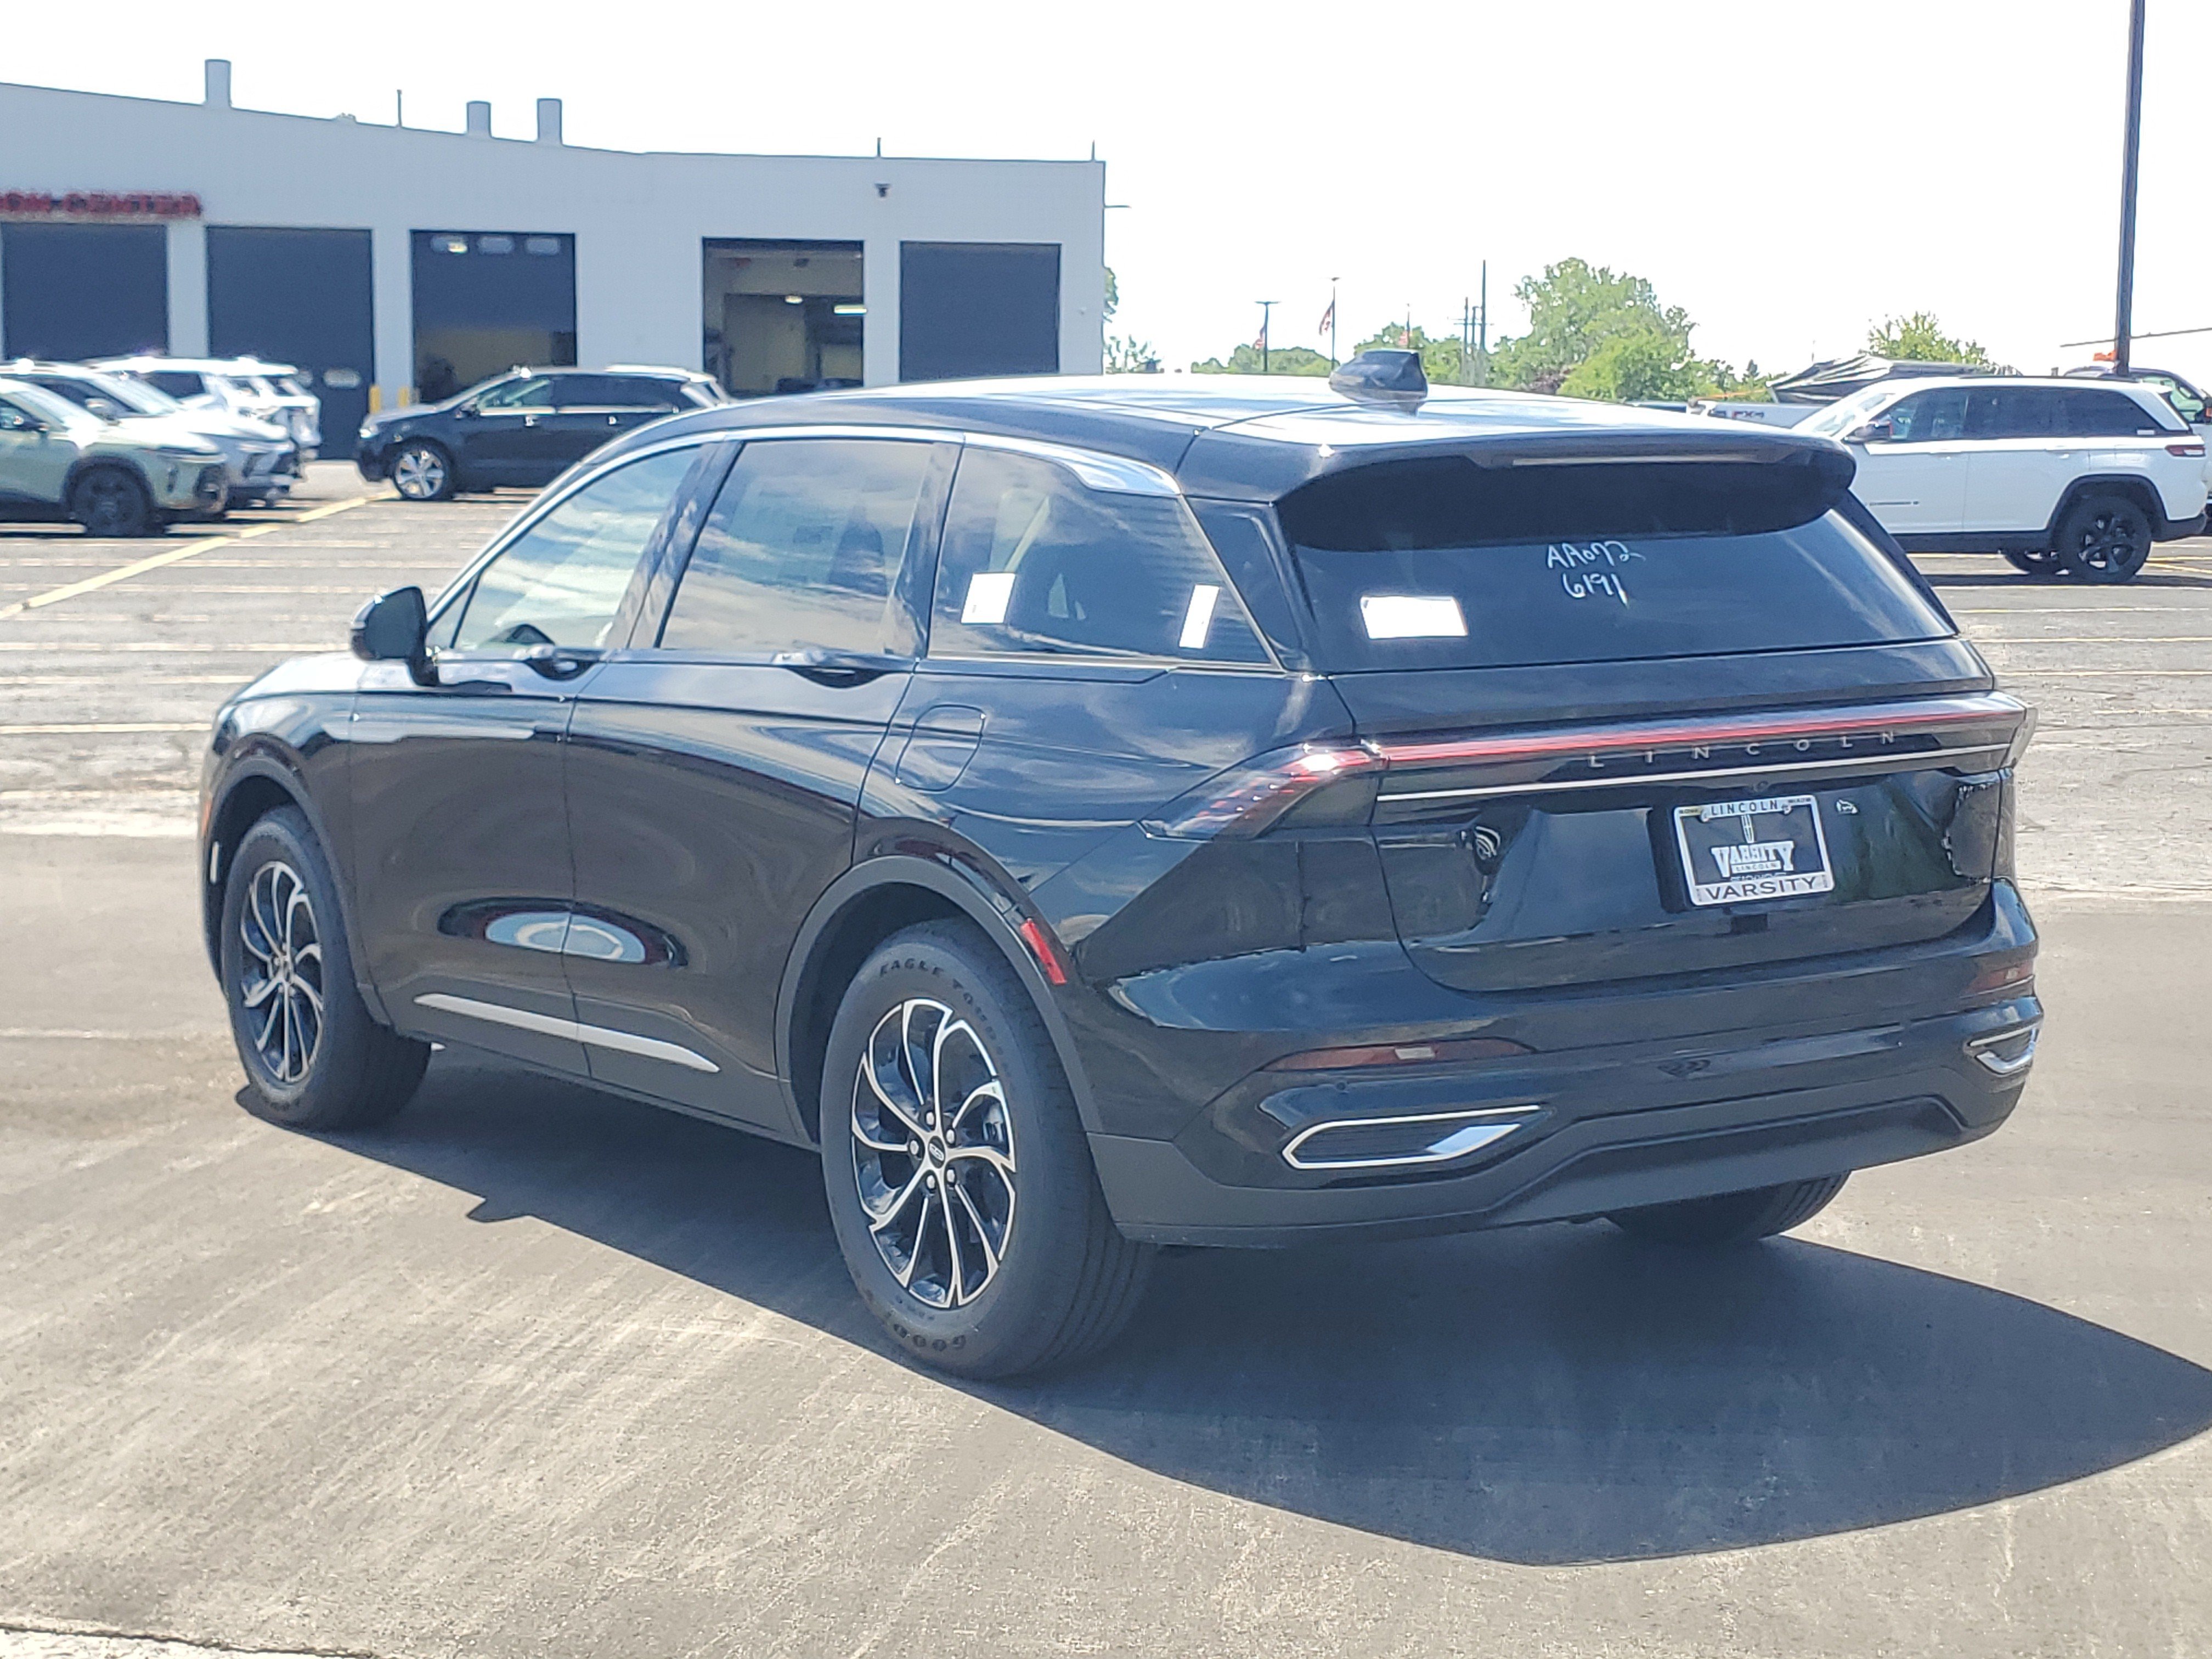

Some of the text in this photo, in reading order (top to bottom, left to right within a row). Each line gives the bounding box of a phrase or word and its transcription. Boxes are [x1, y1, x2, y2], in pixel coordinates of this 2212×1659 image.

[1588, 730, 1897, 769] LINCOLN
[1711, 800, 1779, 816] LINCOLN
[1711, 840, 1795, 878] VARSITY
[1736, 861, 1778, 872] LINCOLN
[1705, 877, 1817, 901] VARSITY
[879, 958, 944, 978] EAGLE
